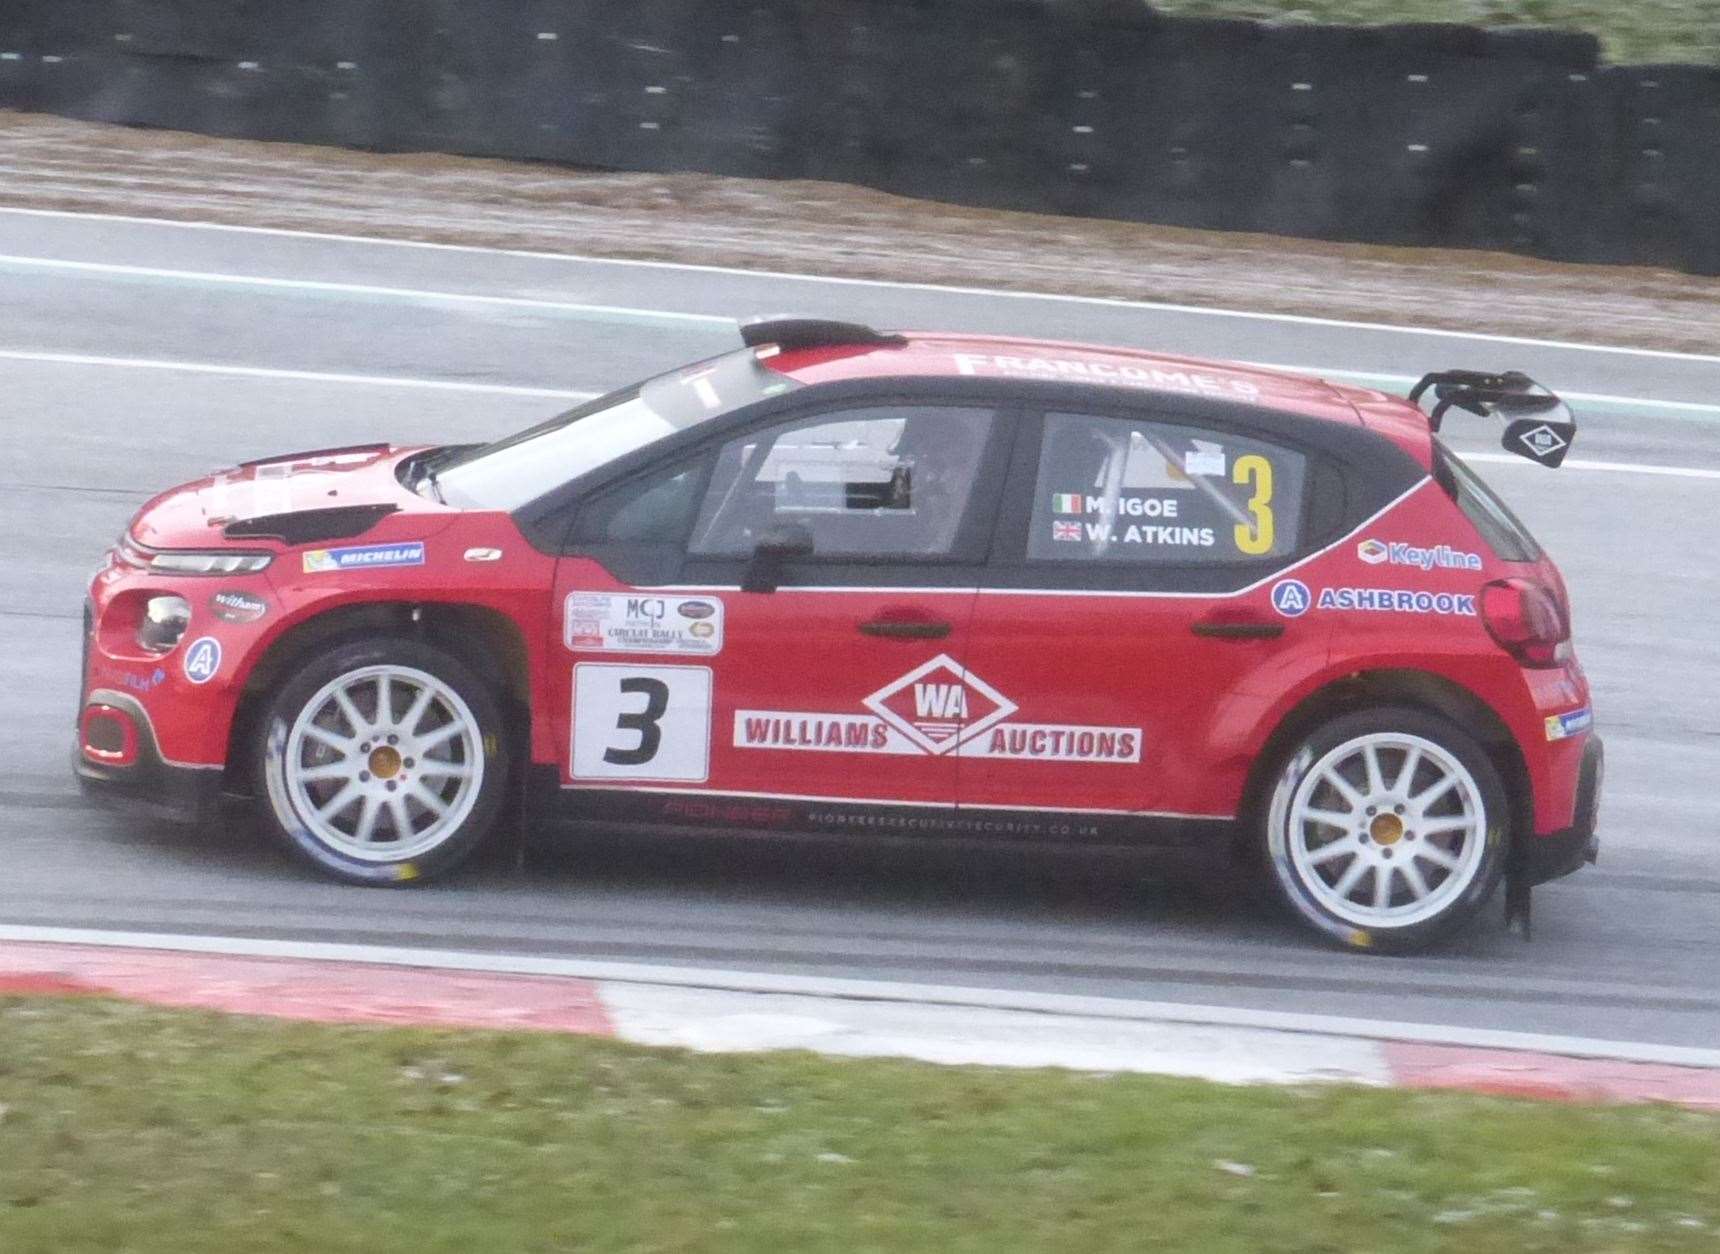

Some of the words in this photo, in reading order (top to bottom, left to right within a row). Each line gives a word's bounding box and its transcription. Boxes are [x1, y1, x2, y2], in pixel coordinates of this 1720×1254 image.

[1119, 497, 1178, 518] IGOE
[1232, 454, 1274, 555] 3
[1085, 523, 1118, 542] W.
[1123, 525, 1215, 546] ATKINS
[340, 549, 422, 564] MICHELIN
[1389, 541, 1483, 571] Keyline
[1316, 587, 1477, 616] ASHBROOK
[915, 683, 968, 719] WA
[603, 677, 670, 765] 3
[745, 717, 889, 748] WILLIAMS
[988, 727, 1135, 758] AUCTIONS
